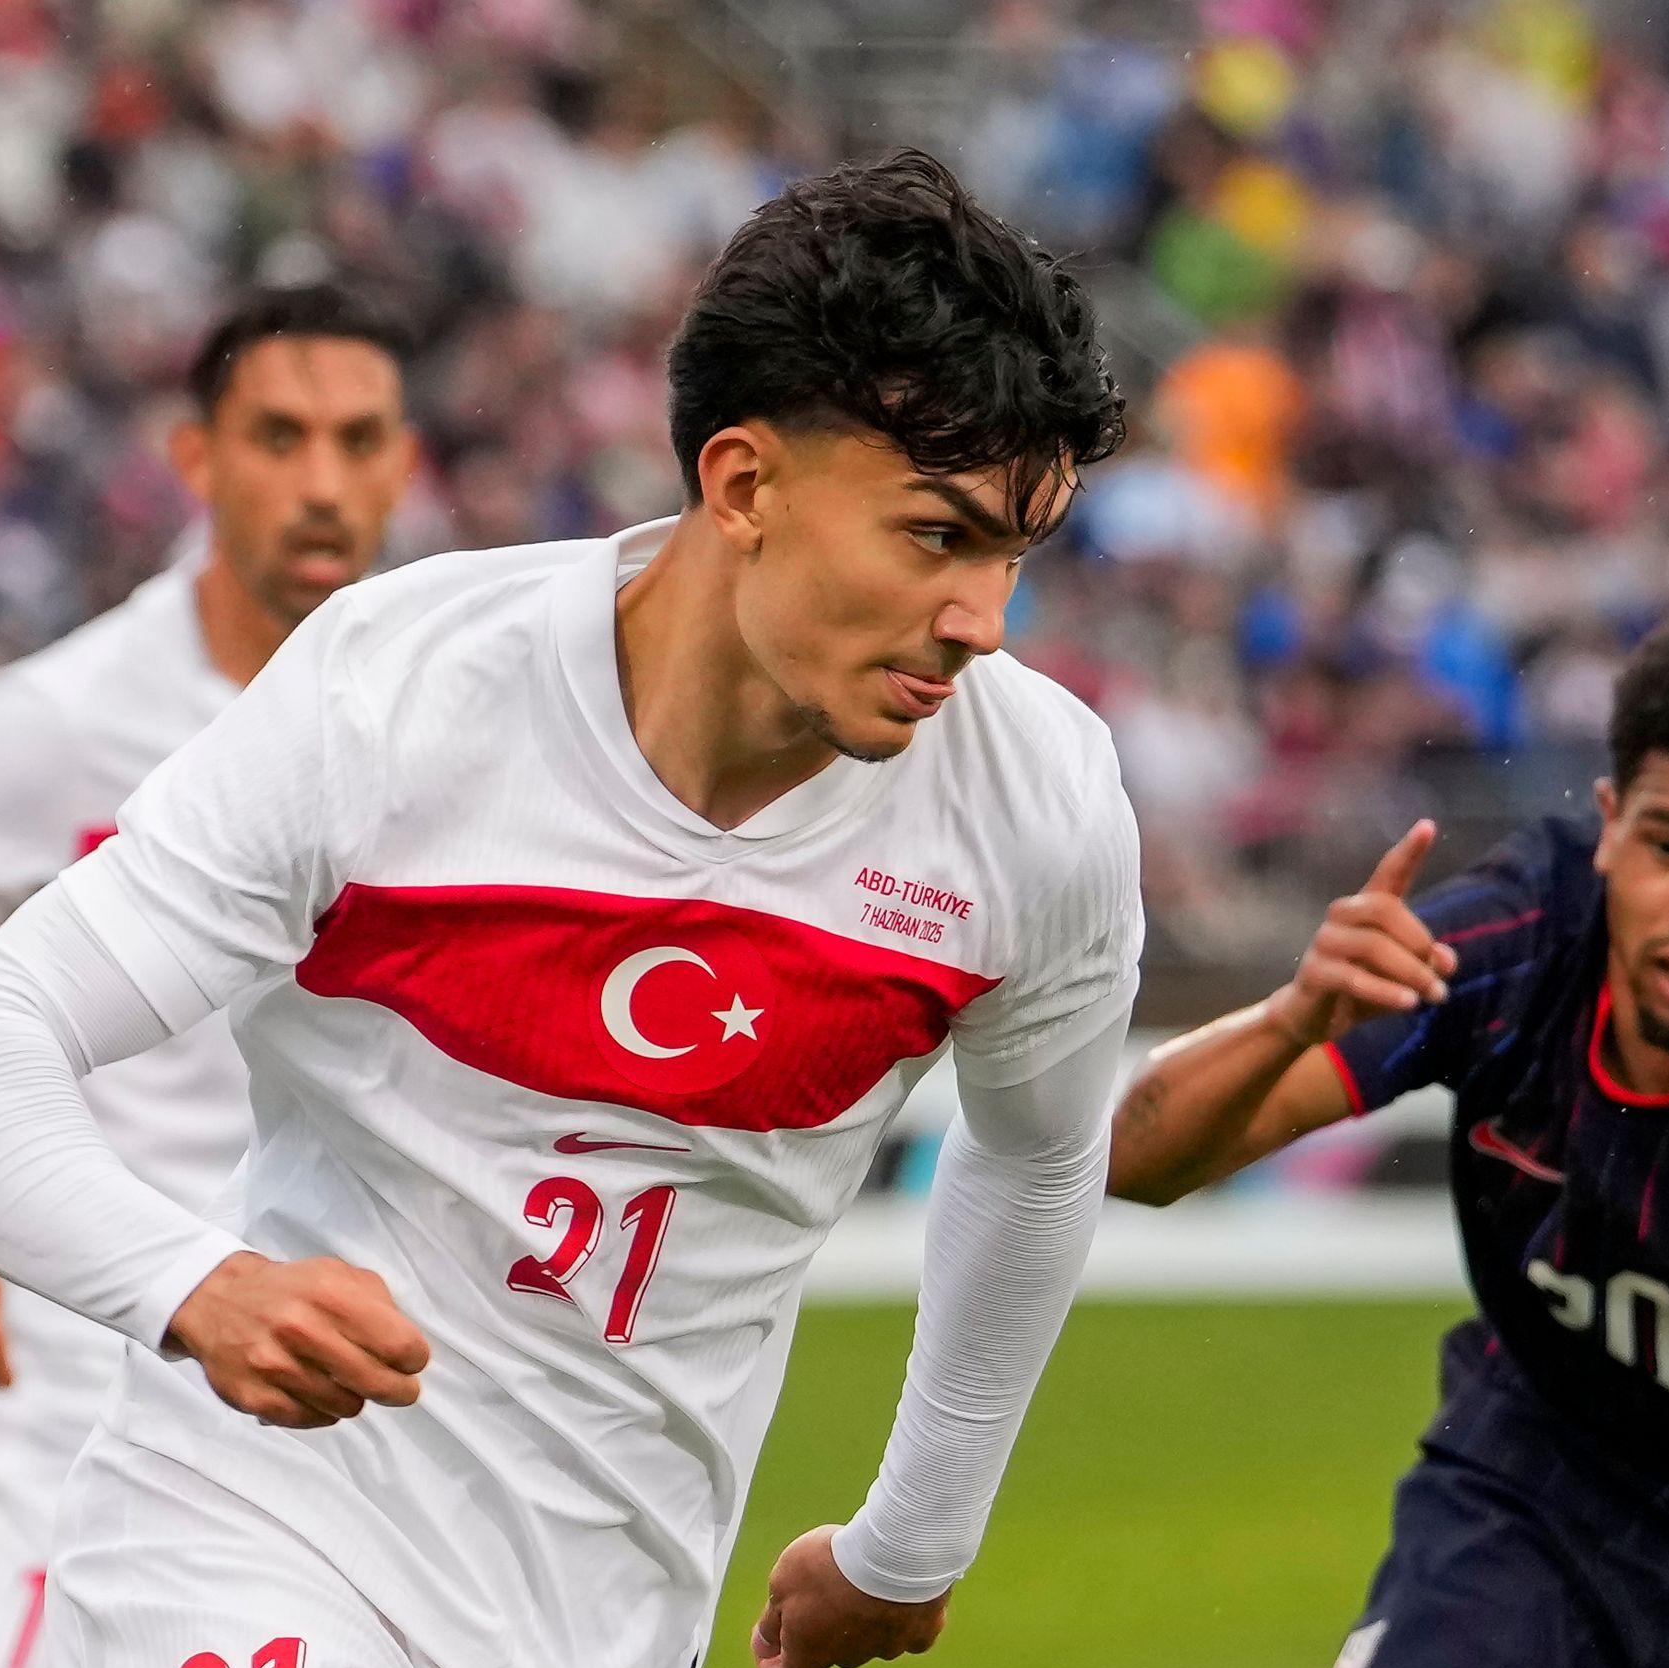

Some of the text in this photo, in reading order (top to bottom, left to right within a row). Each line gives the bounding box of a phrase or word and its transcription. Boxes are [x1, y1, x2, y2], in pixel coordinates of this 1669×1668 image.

[854, 867, 974, 920] ABD-TÜRKİYE
[860, 903, 945, 944] 7 HAZİRAN 2025
[506, 1175, 676, 1344] 21
